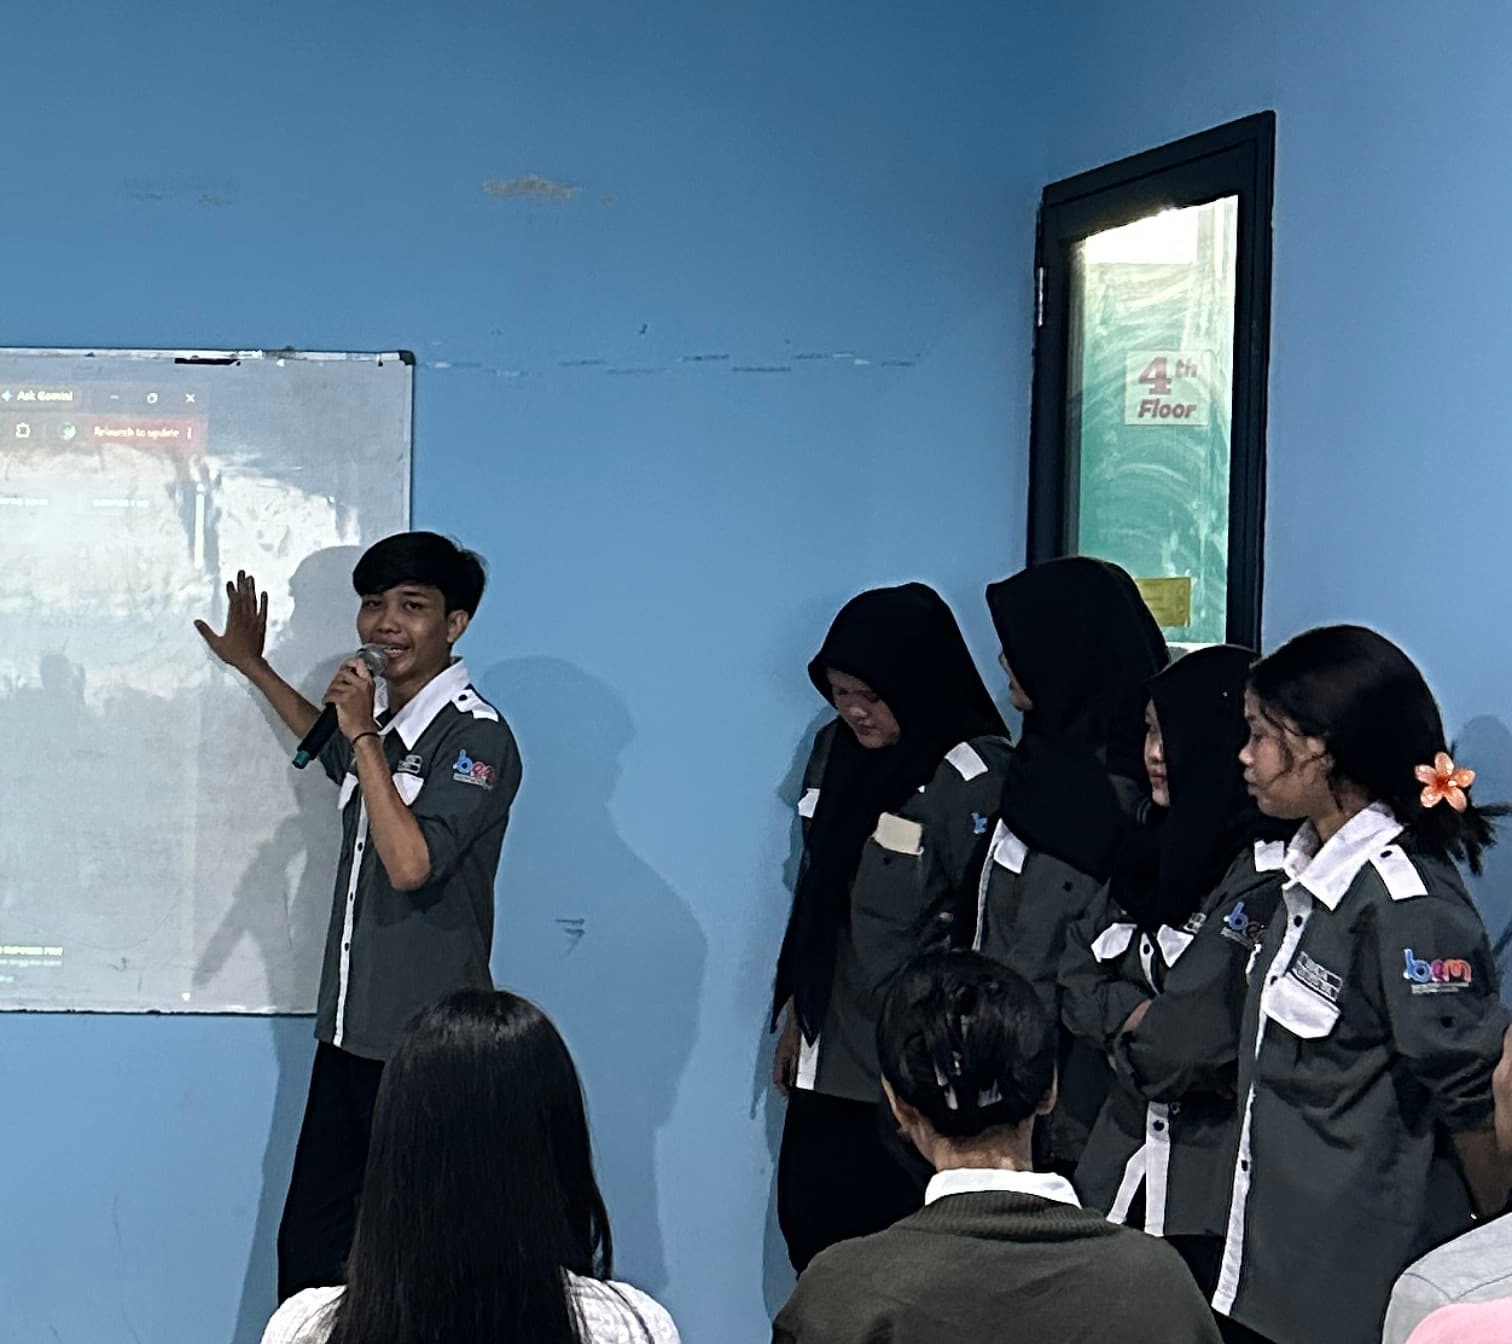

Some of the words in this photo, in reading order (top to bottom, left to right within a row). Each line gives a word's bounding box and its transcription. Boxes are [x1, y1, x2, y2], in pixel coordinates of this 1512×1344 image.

[1138, 356, 1197, 395] 4th
[17, 390, 35, 401] Ask
[37, 390, 73, 401] Gemini
[1137, 398, 1197, 418] Floor
[94, 426, 134, 437] Relaunch
[136, 427, 145, 437] to
[147, 428, 180, 439] update
[1403, 948, 1472, 983] bem
